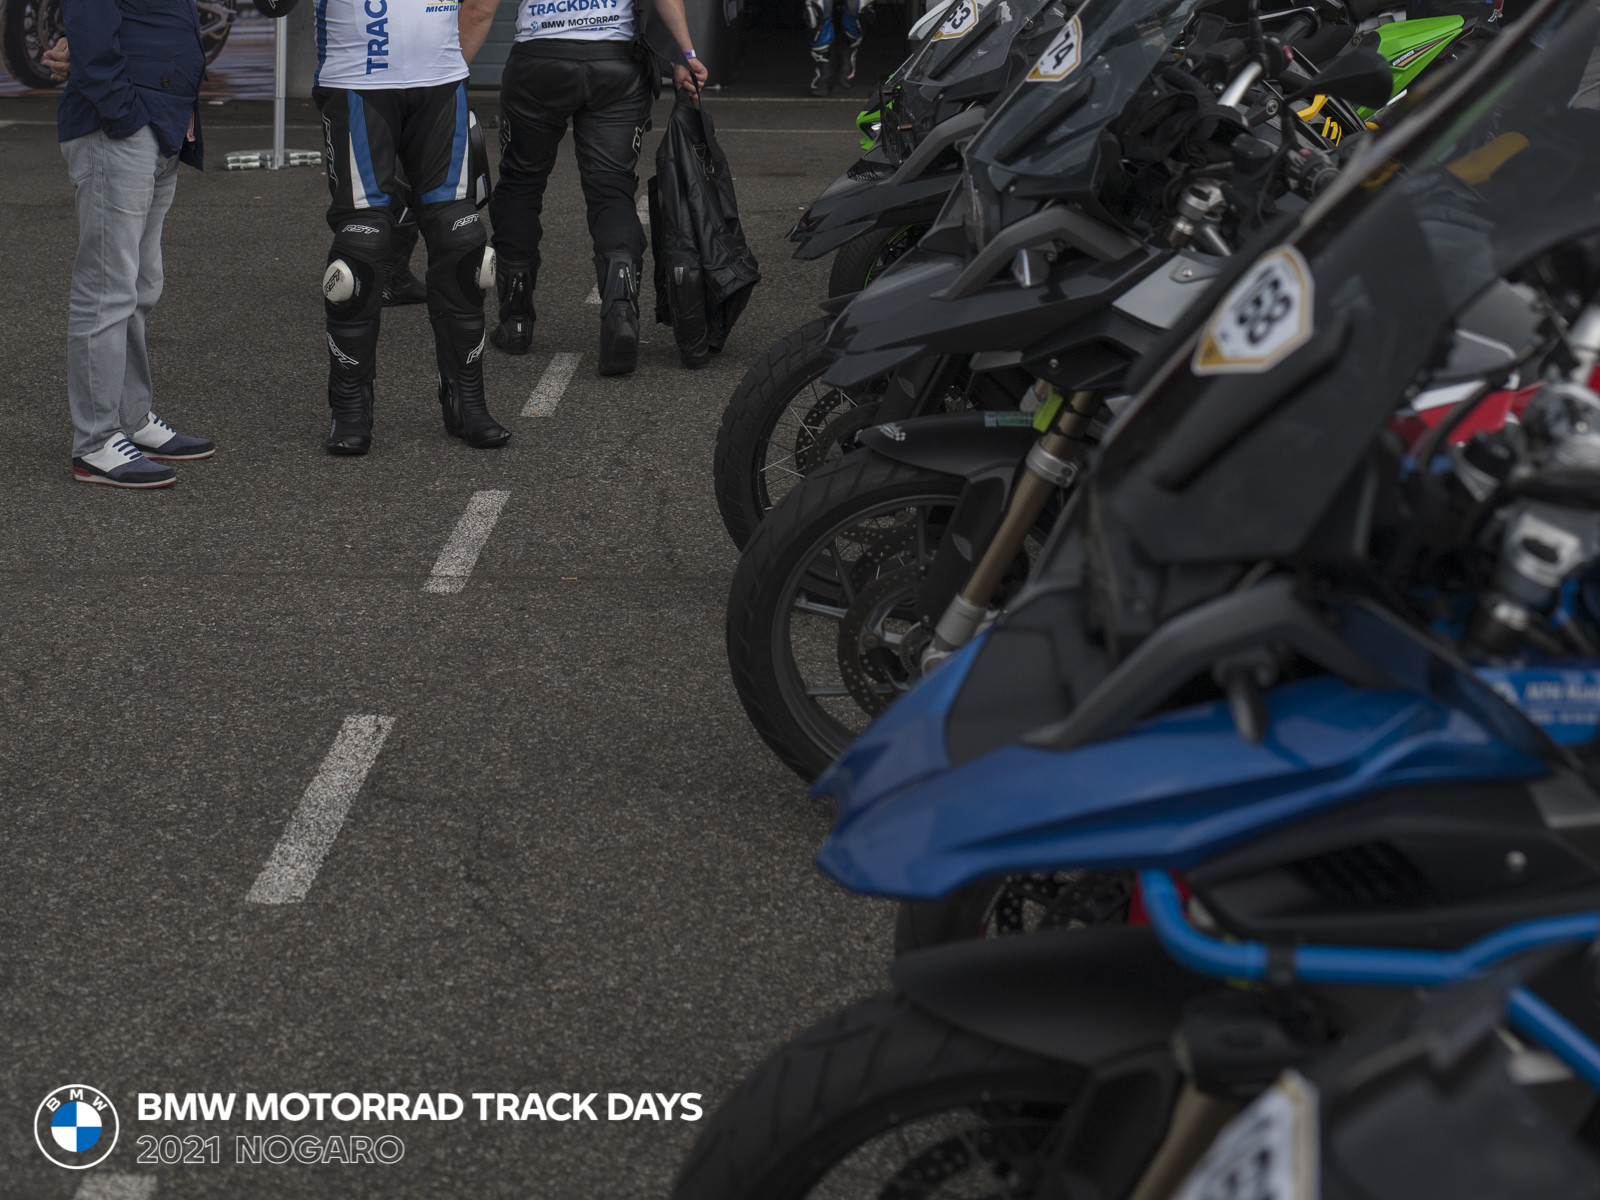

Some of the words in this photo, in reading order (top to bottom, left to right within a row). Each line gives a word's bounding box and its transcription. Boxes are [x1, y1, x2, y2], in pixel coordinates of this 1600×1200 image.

[541, 19, 565, 29] BMW
[568, 14, 620, 27] MOTORRAD
[342, 224, 379, 235] RST
[452, 213, 480, 231] RST
